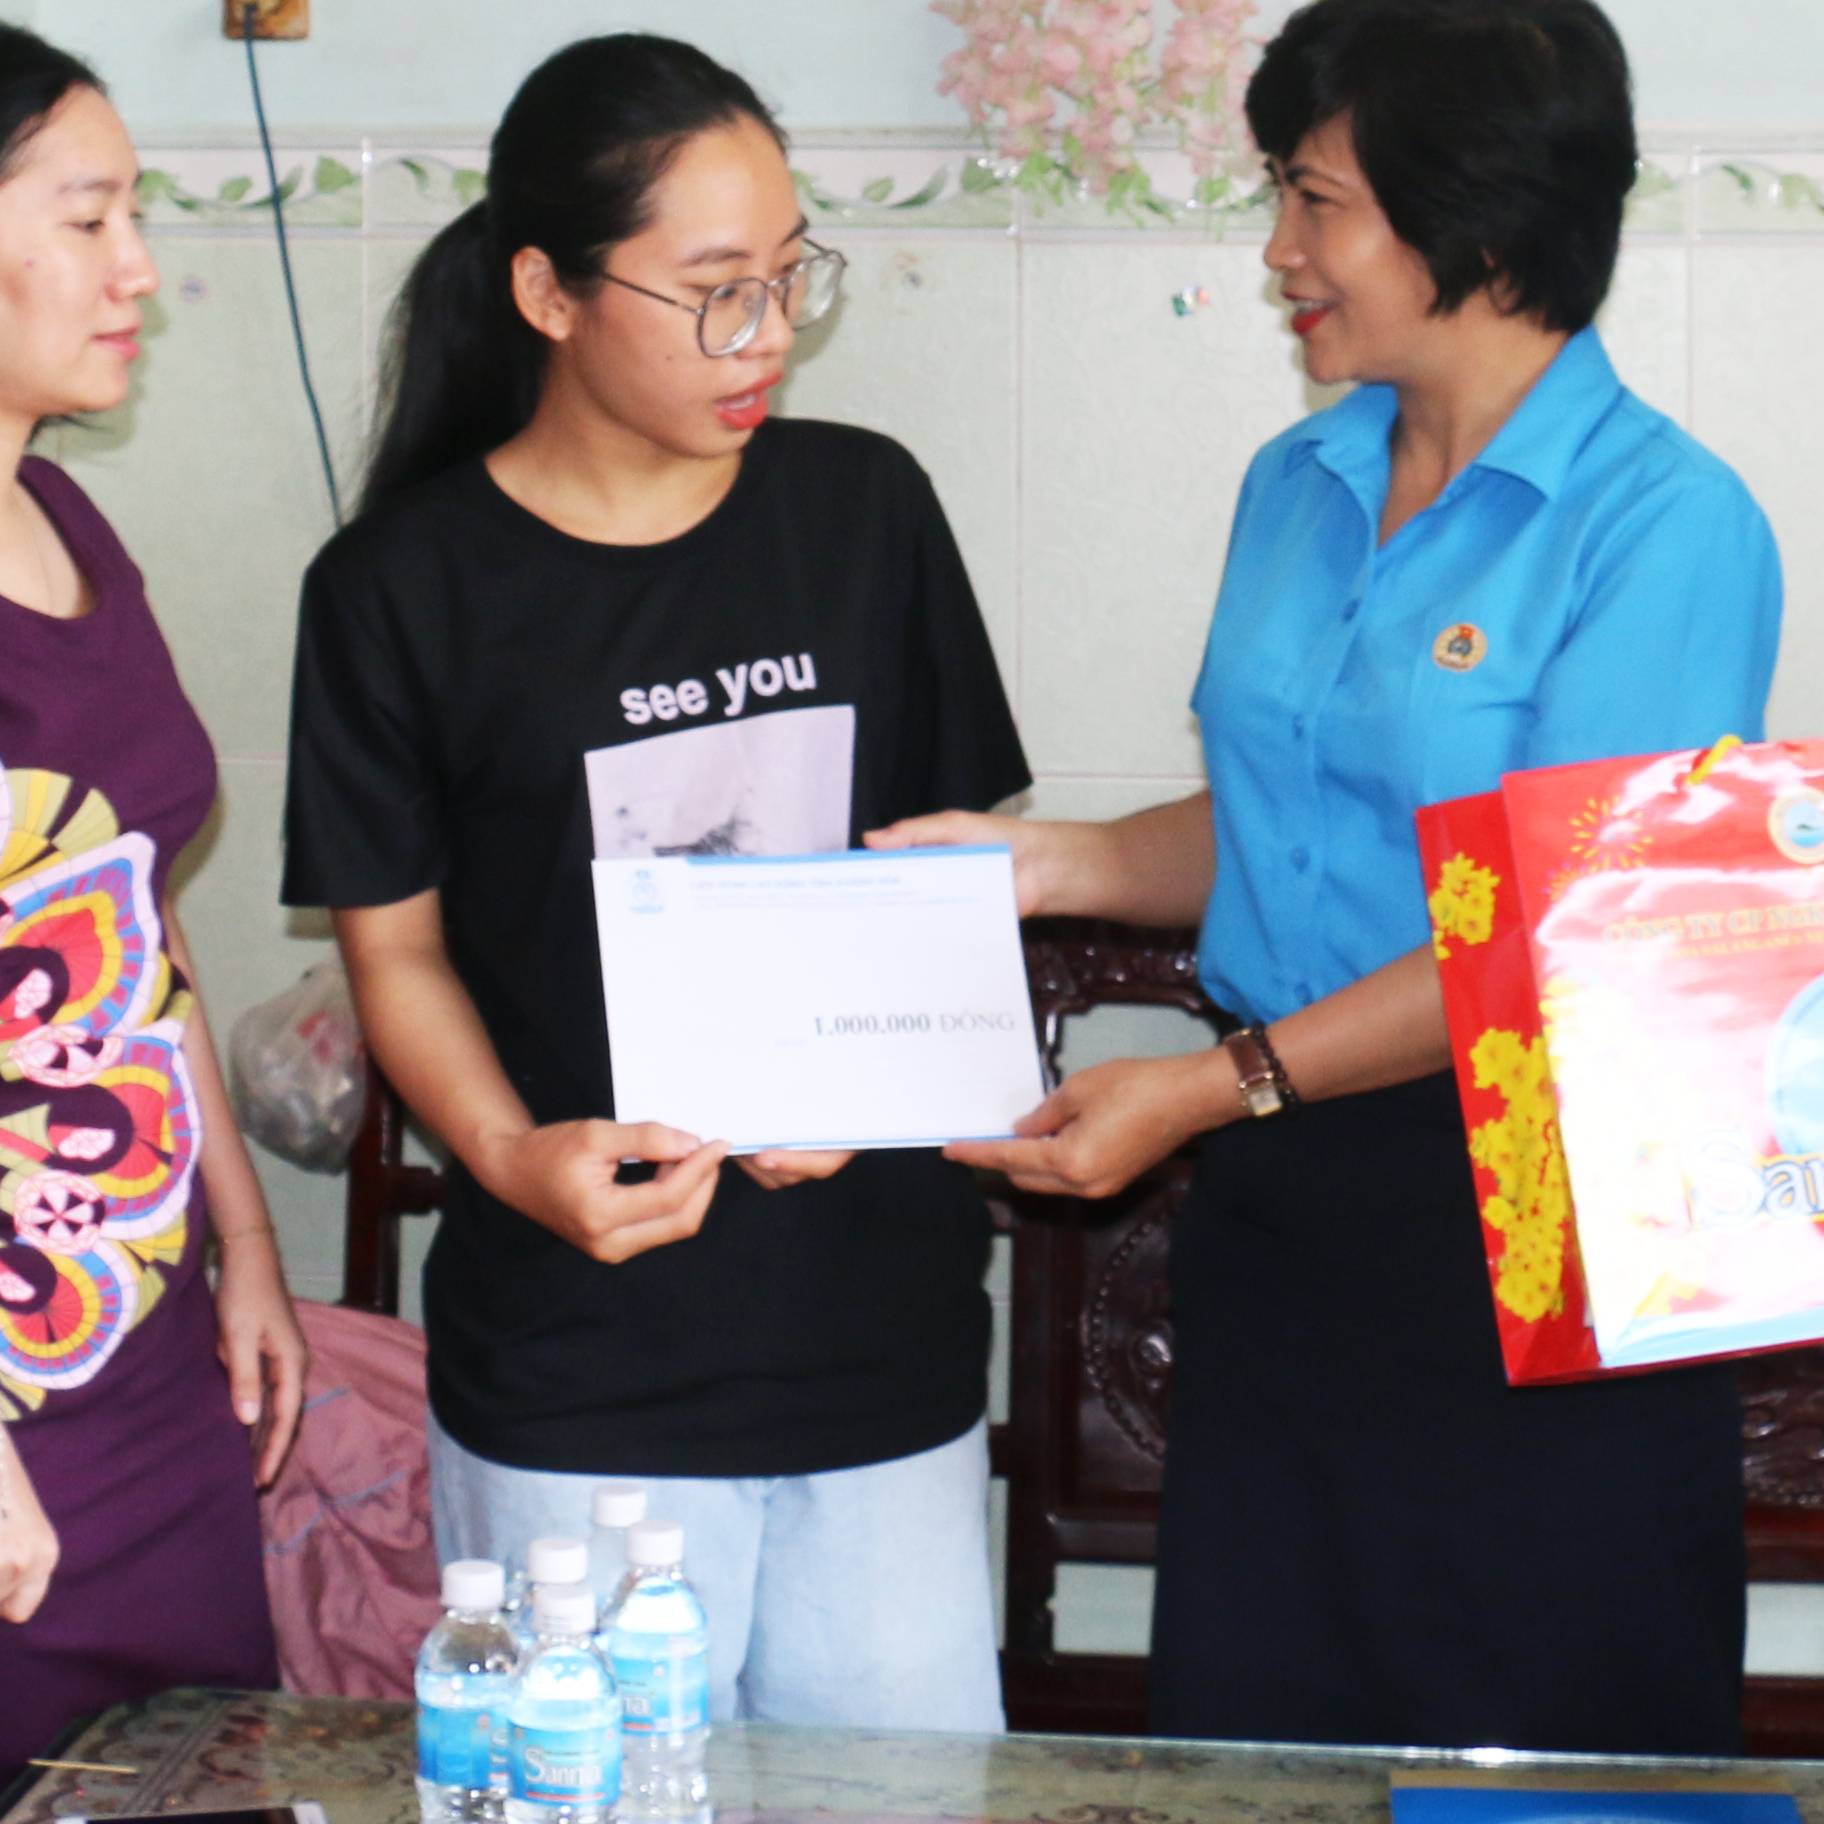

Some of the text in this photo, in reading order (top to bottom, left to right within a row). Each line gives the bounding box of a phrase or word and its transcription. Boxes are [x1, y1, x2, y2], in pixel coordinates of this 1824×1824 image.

[619, 652, 818, 726] see you
[1687, 913, 1724, 940] TY
[814, 1013, 931, 1037] 1.000.000
